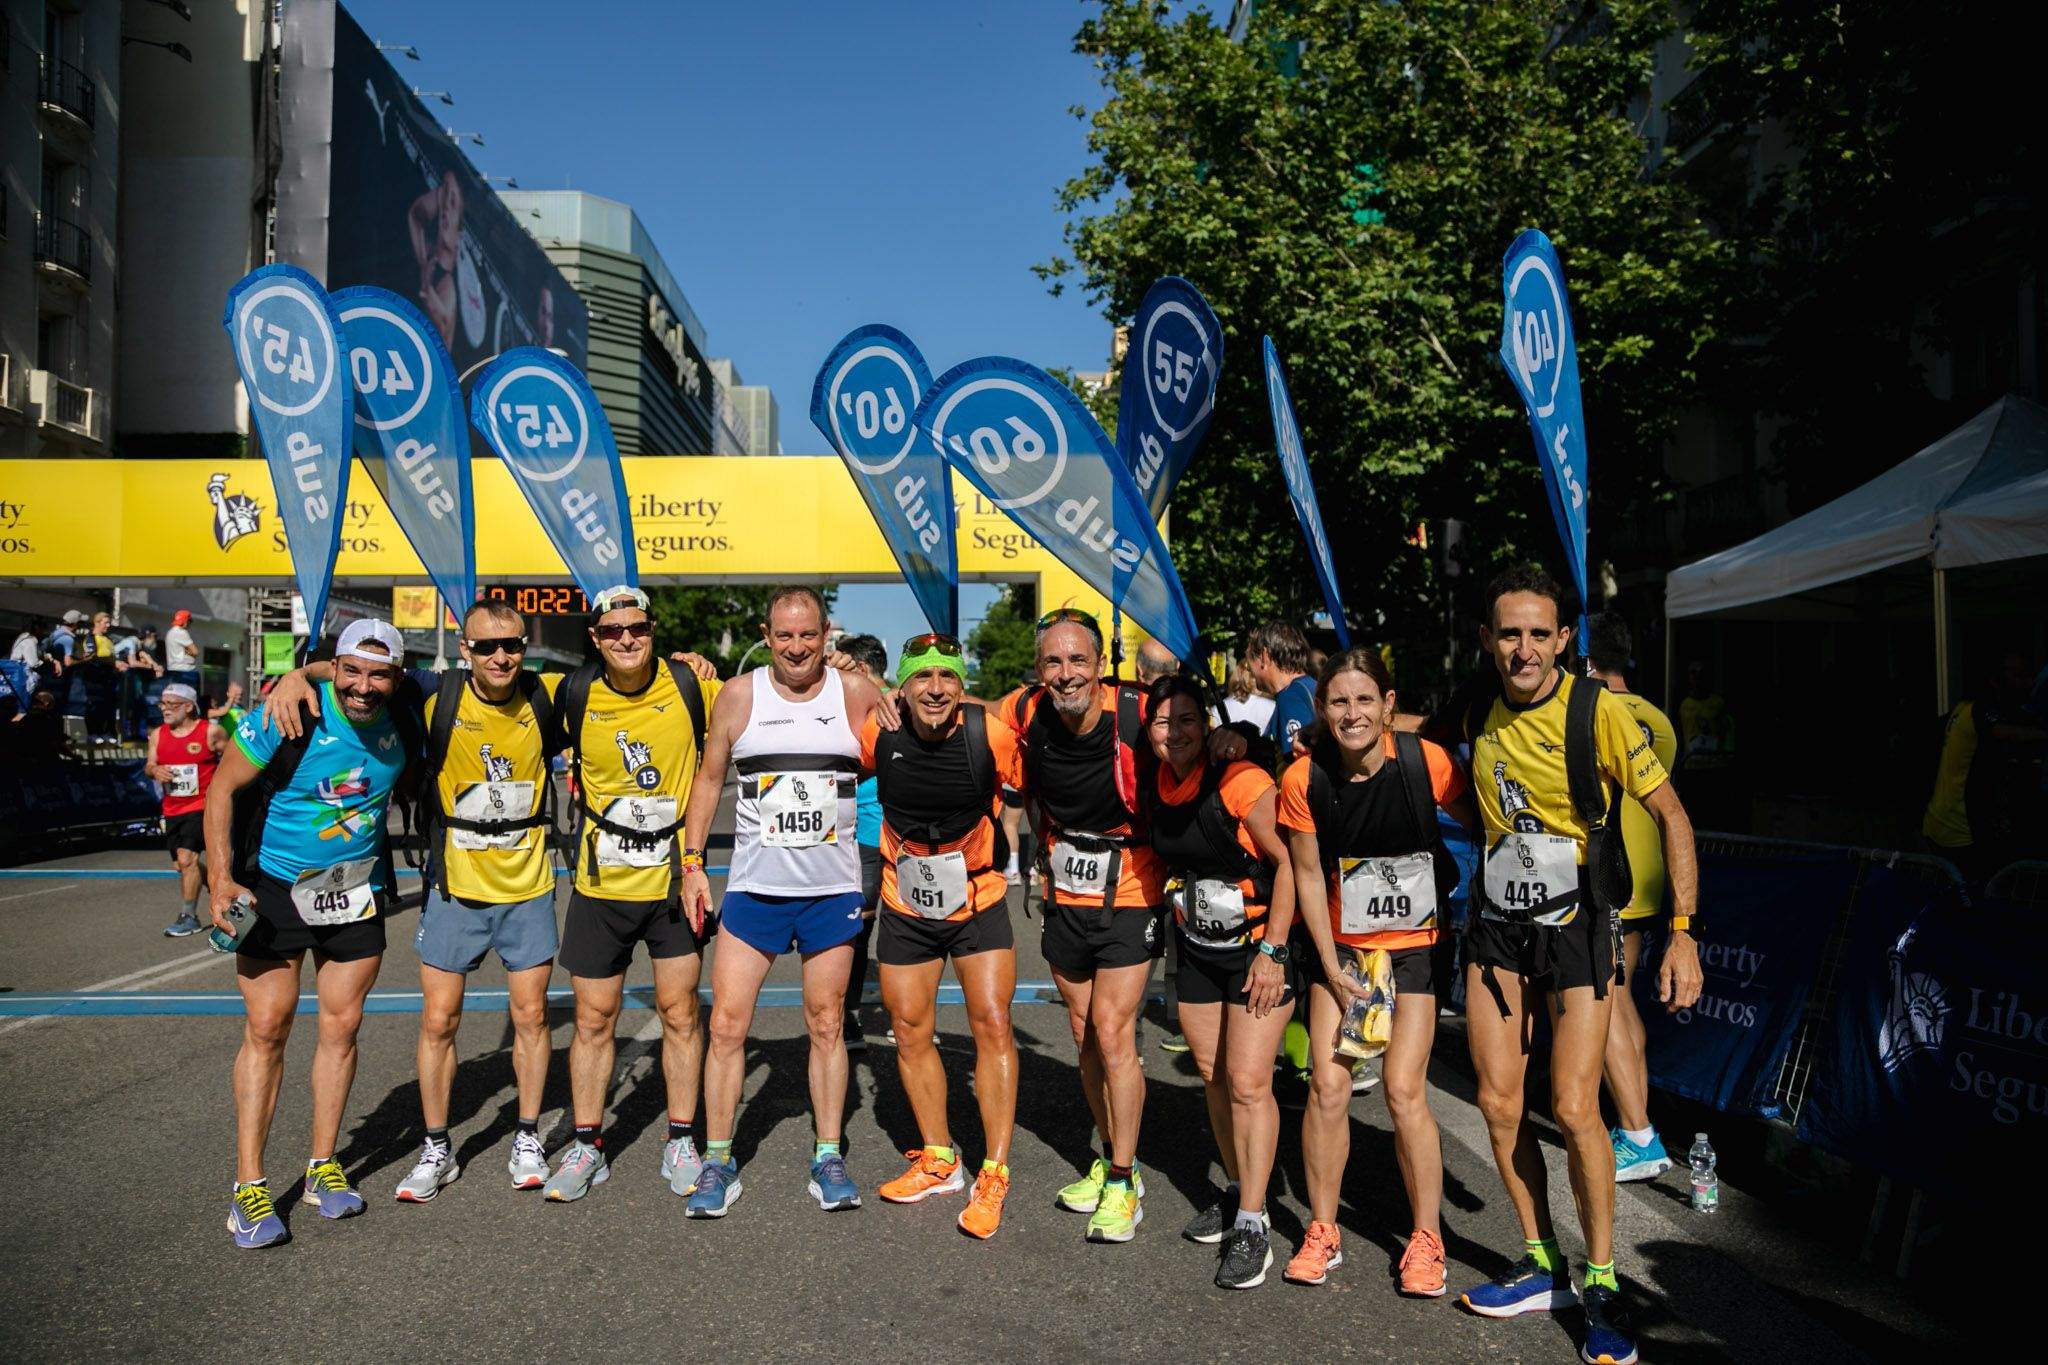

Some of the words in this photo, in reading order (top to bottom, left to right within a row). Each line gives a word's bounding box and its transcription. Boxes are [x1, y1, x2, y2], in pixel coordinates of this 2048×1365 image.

[1154, 339, 1201, 404] 55
[1133, 431, 1165, 495] ub
[637, 534, 728, 561] eguros
[972, 528, 1044, 559] Segu
[640, 771, 657, 786] 13
[775, 810, 823, 834] 1458
[1518, 819, 1539, 834] 13
[1064, 856, 1099, 881] 448
[314, 889, 350, 914] 445
[911, 887, 944, 909] 451
[1504, 880, 1549, 908] 443
[1366, 895, 1411, 919] 449
[1196, 919, 1226, 934] 50
